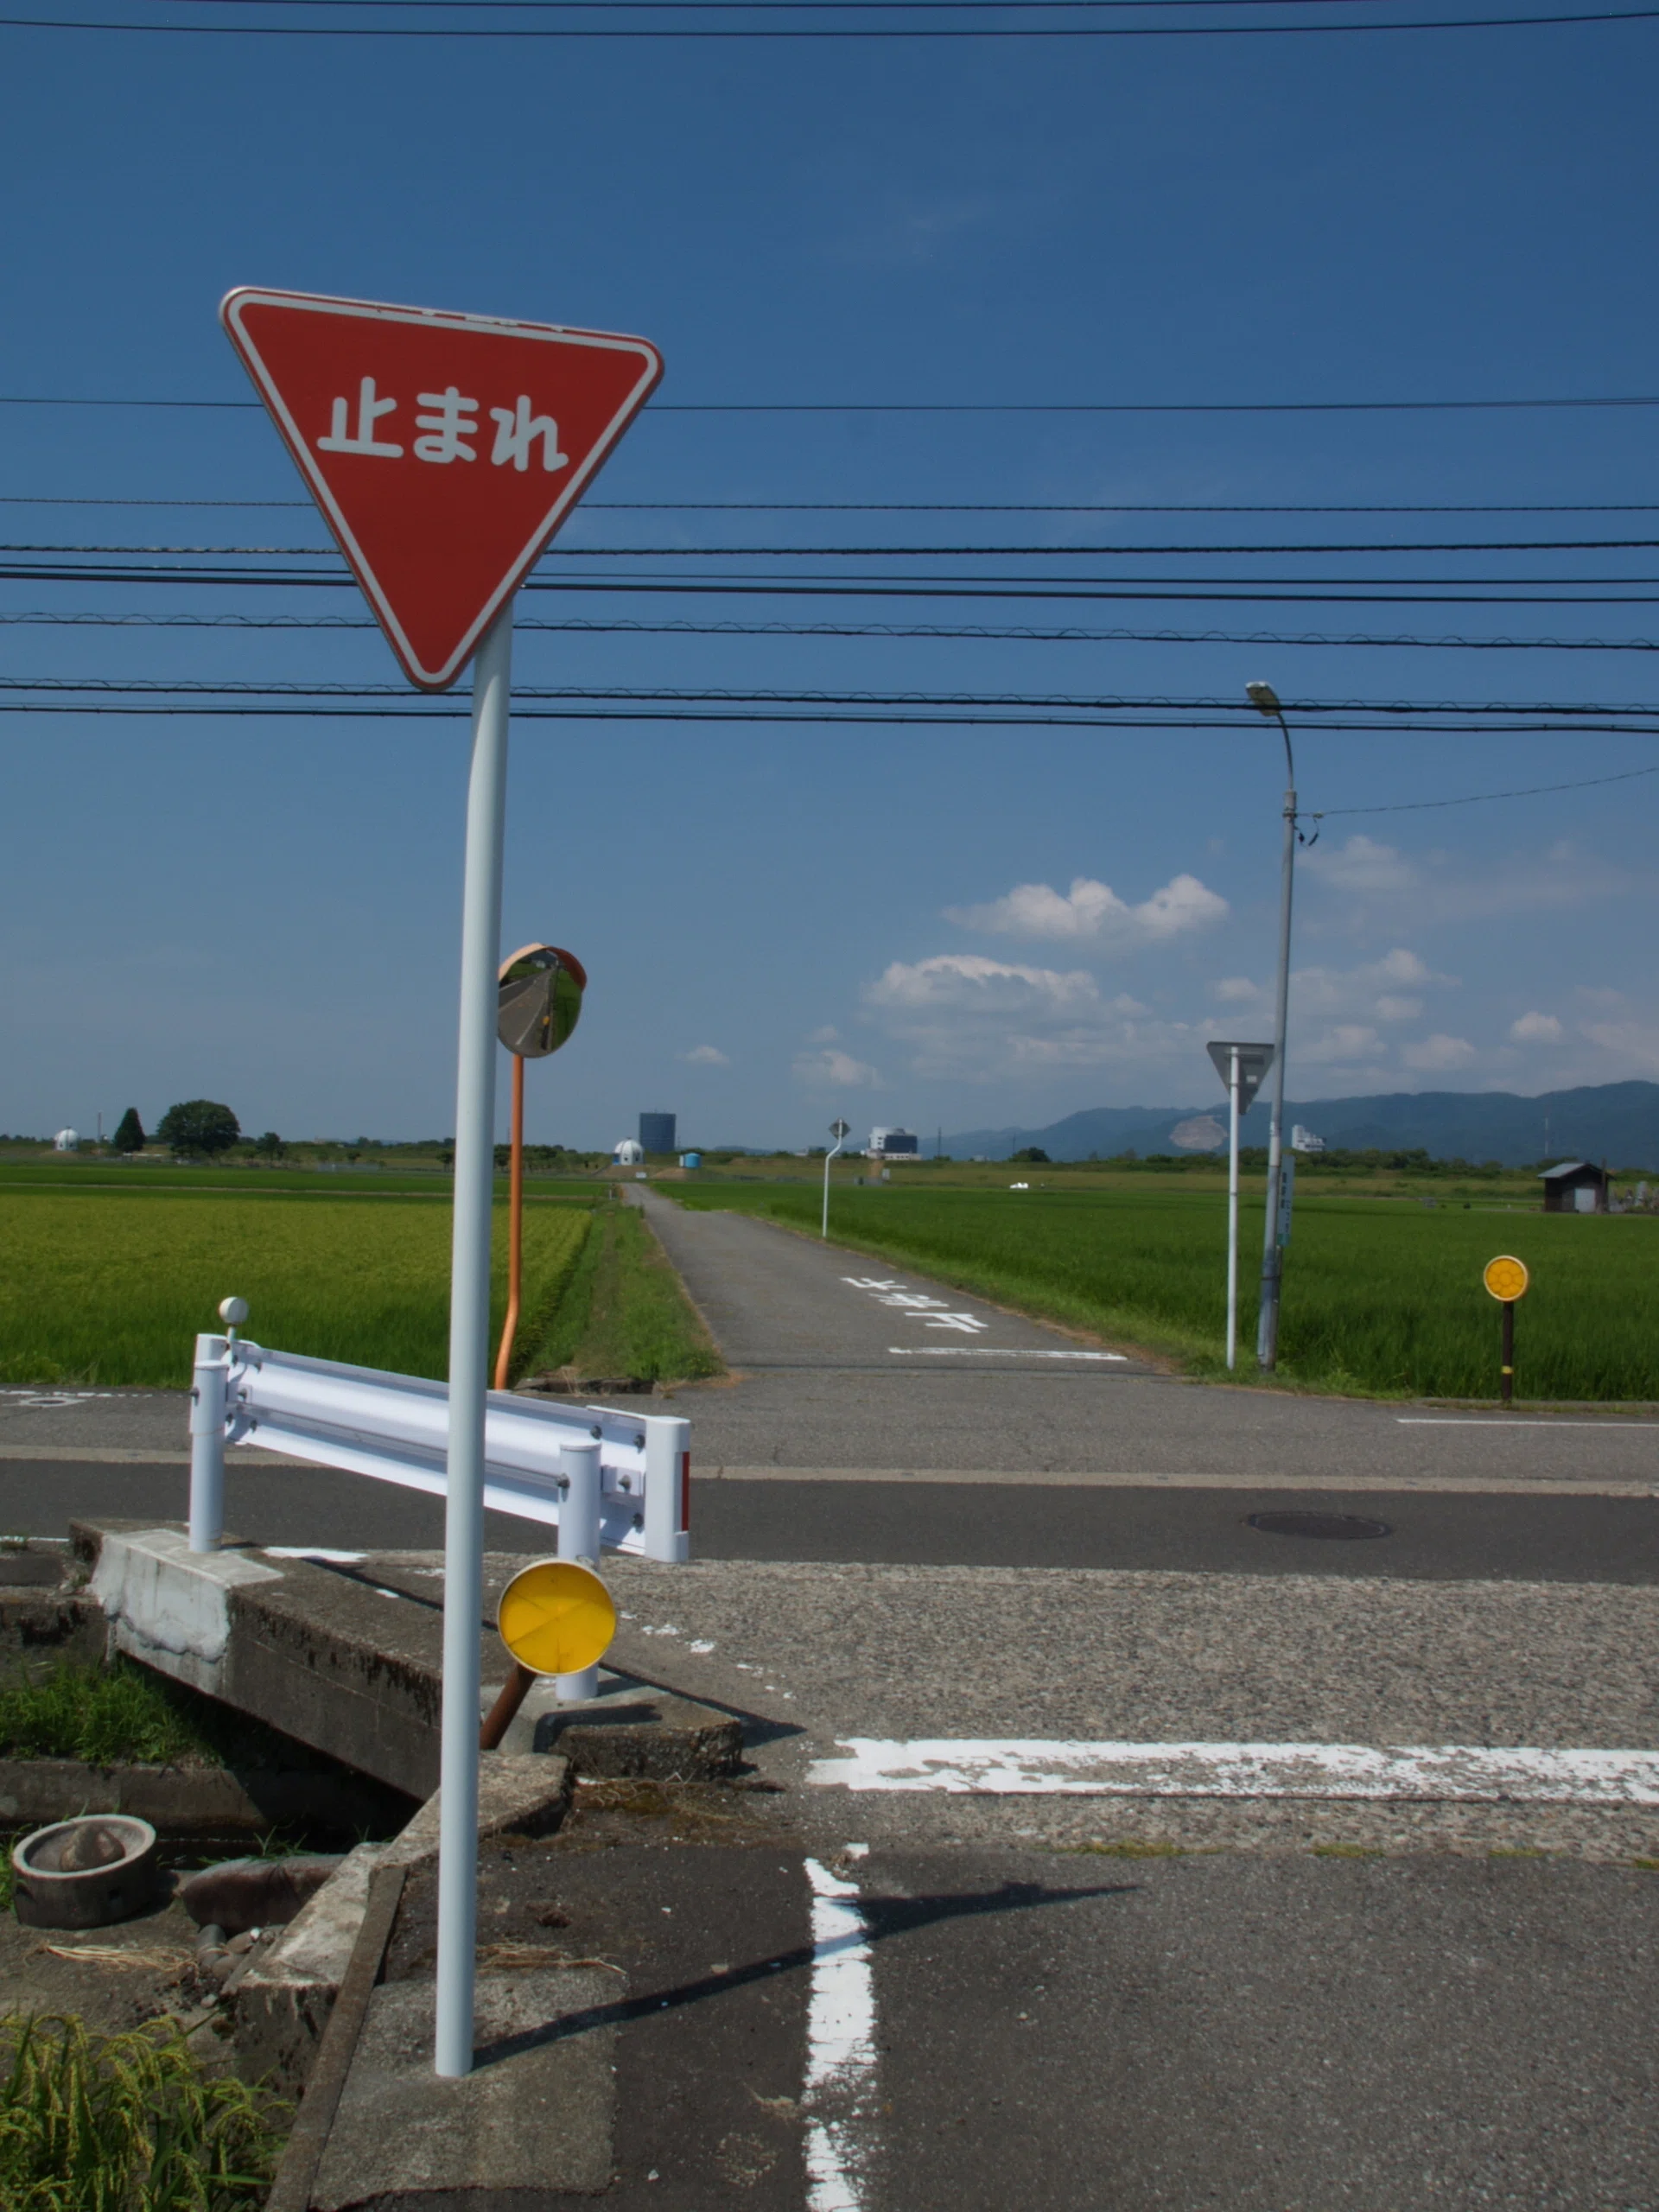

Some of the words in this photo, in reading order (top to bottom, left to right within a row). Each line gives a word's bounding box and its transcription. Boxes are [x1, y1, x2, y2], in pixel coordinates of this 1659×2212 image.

[317, 376, 569, 472] 止まれ
[840, 1277, 988, 1333] 止まれ
